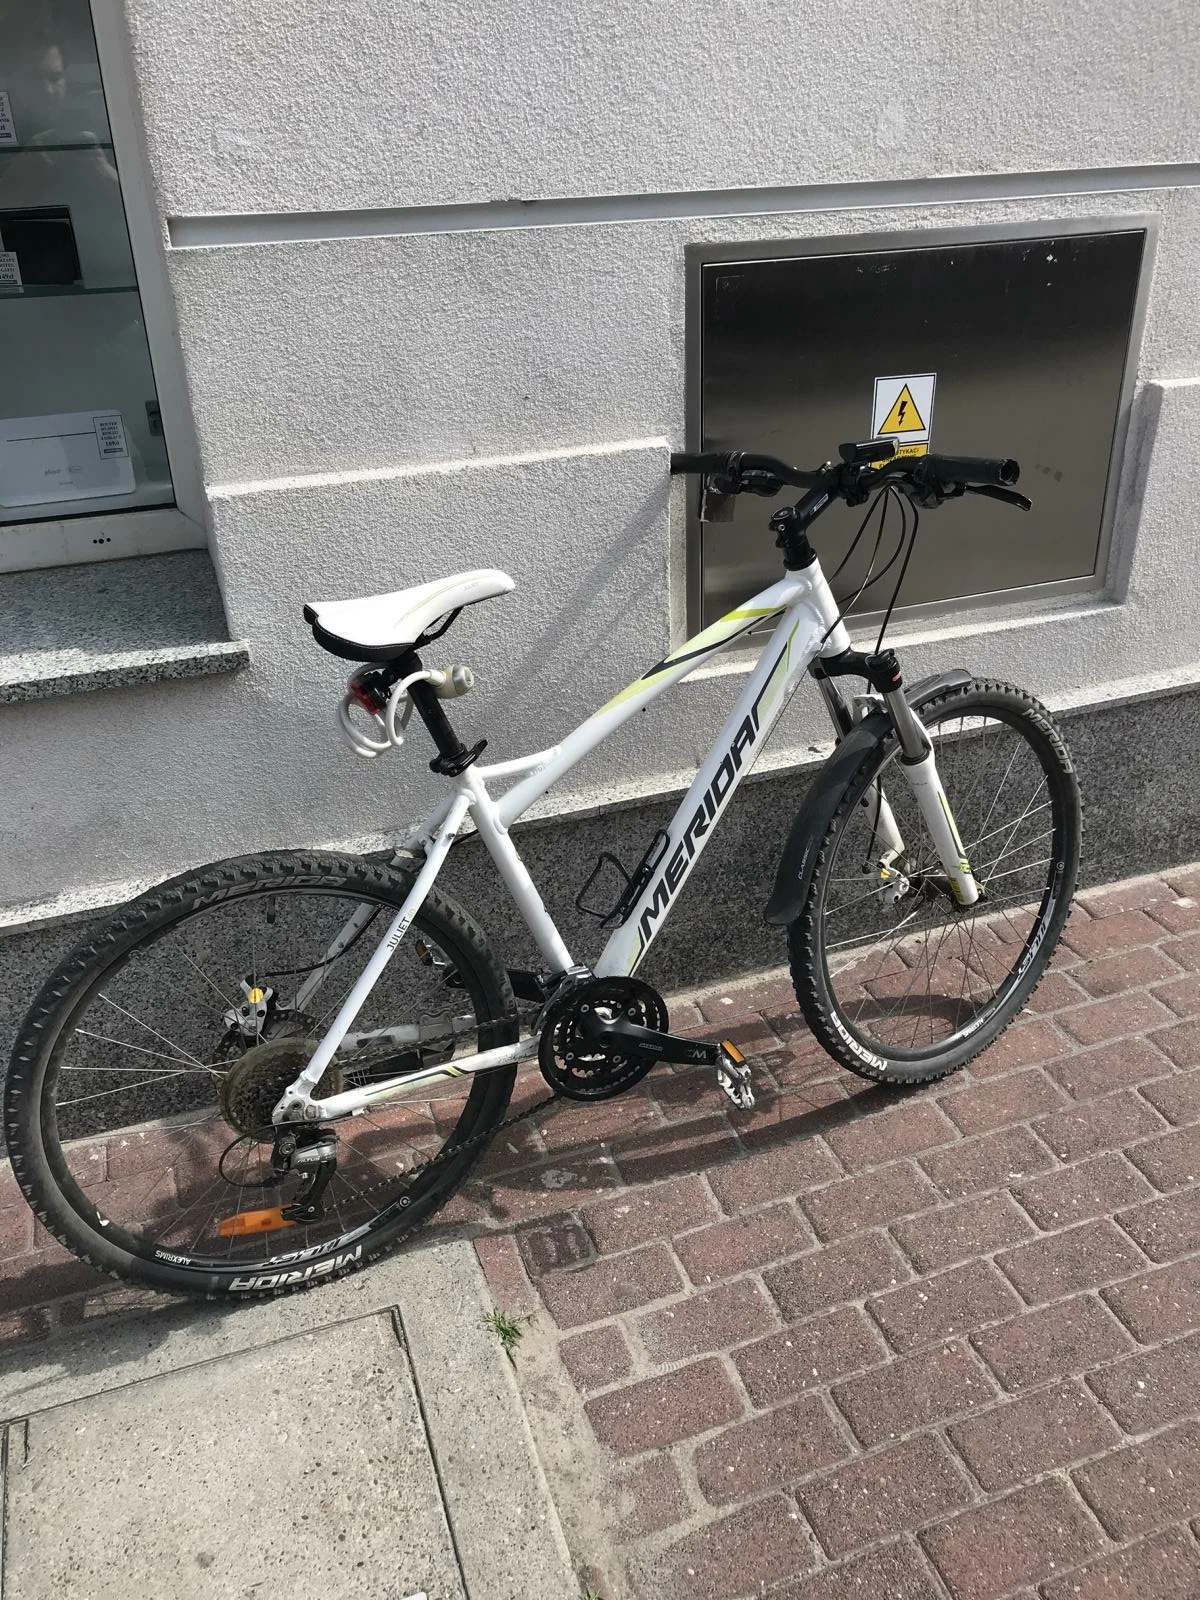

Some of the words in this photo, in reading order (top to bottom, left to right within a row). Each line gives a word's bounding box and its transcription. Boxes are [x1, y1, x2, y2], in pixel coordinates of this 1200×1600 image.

[1022, 707, 1074, 774] MERIDA
[638, 706, 760, 948] MERIDA
[386, 916, 410, 952] JULIET
[830, 1010, 888, 1072] MERIDA
[155, 1249, 192, 1266] ALEXRIMS
[228, 1245, 362, 1292] MERIDA
